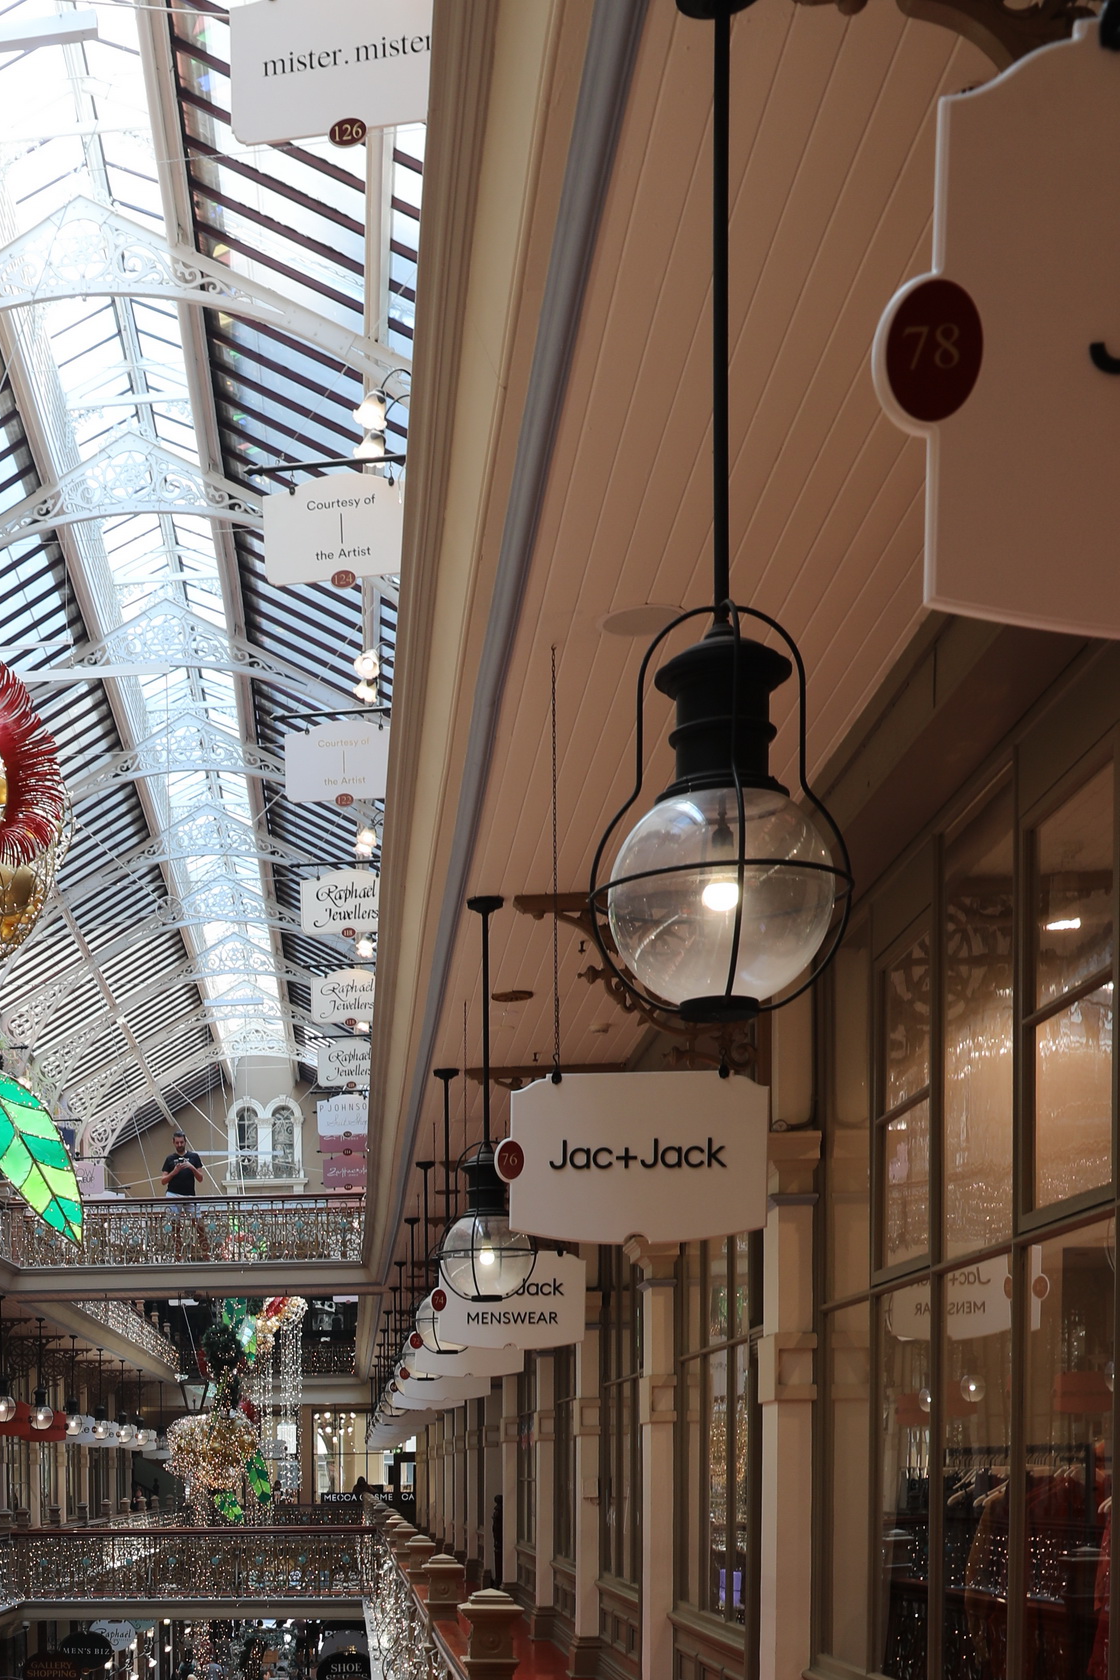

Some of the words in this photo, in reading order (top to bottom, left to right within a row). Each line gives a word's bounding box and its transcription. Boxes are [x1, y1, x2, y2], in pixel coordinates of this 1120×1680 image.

[334, 122, 363, 142] 126
[902, 323, 960, 371] 78
[306, 498, 361, 511] Courtesy
[364, 493, 376, 505] of
[315, 551, 334, 561] the
[338, 546, 371, 559] Artist
[334, 574, 354, 584] 124
[317, 739, 359, 748] Courtesy
[360, 737, 370, 745] of
[324, 778, 338, 786] the
[341, 776, 366, 785] Artist
[313, 902, 379, 928] Jewellers
[320, 995, 374, 1019] Jewellers
[326, 1063, 371, 1081] Jewellers
[501, 1152, 518, 1167] 76
[549, 1136, 728, 1170] Jac+Jack
[435, 1296, 444, 1305] 74
[466, 1311, 559, 1325] MENSWEAR
[324, 1493, 358, 1502] MECCA
[63, 1647, 92, 1655] MEN'S
[94, 1647, 110, 1655] BIZ
[30, 1661, 72, 1670] GALLERY
[330, 1662, 362, 1673] SHOE
[26, 1669, 77, 1678] SHOPPING
